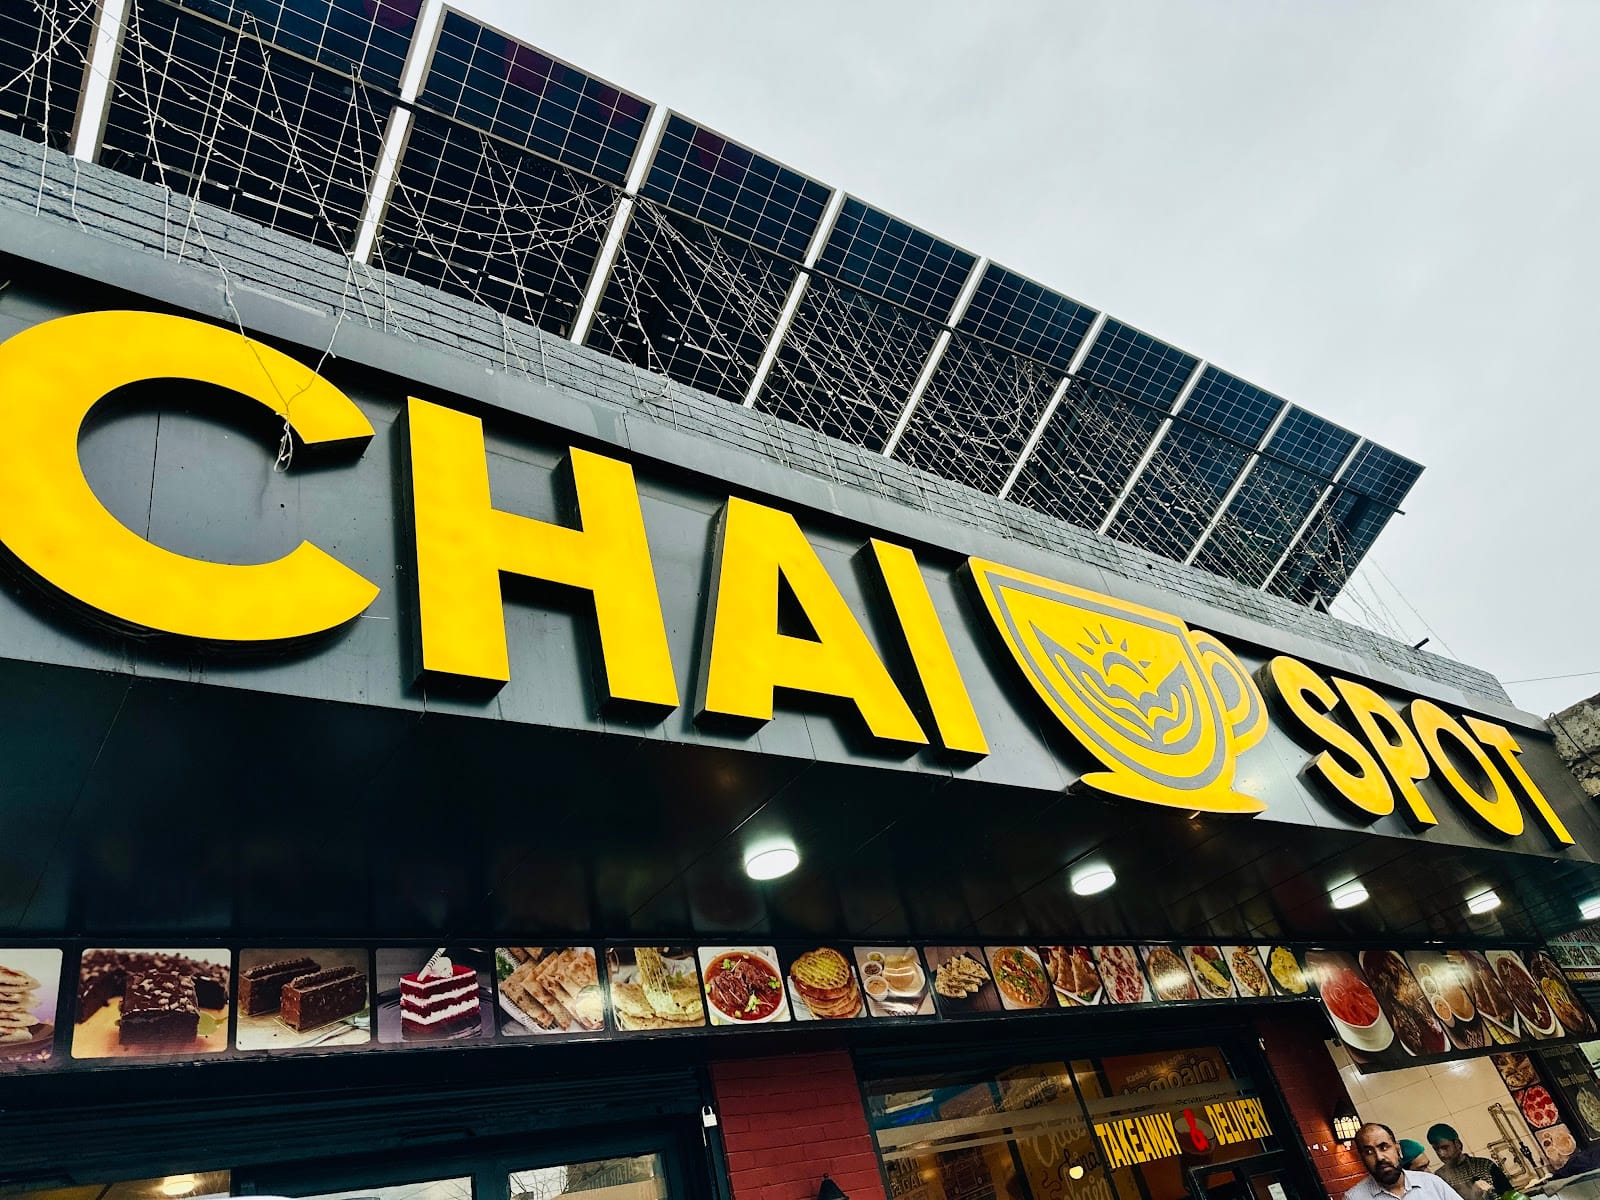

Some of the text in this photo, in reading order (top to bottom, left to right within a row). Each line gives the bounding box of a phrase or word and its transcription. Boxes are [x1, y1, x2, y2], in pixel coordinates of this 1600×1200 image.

[0, 310, 1576, 846] CHAI SPOT
[1093, 1112, 1183, 1169] TAKEAWAY
[1203, 1097, 1273, 1146] DELIVERY
